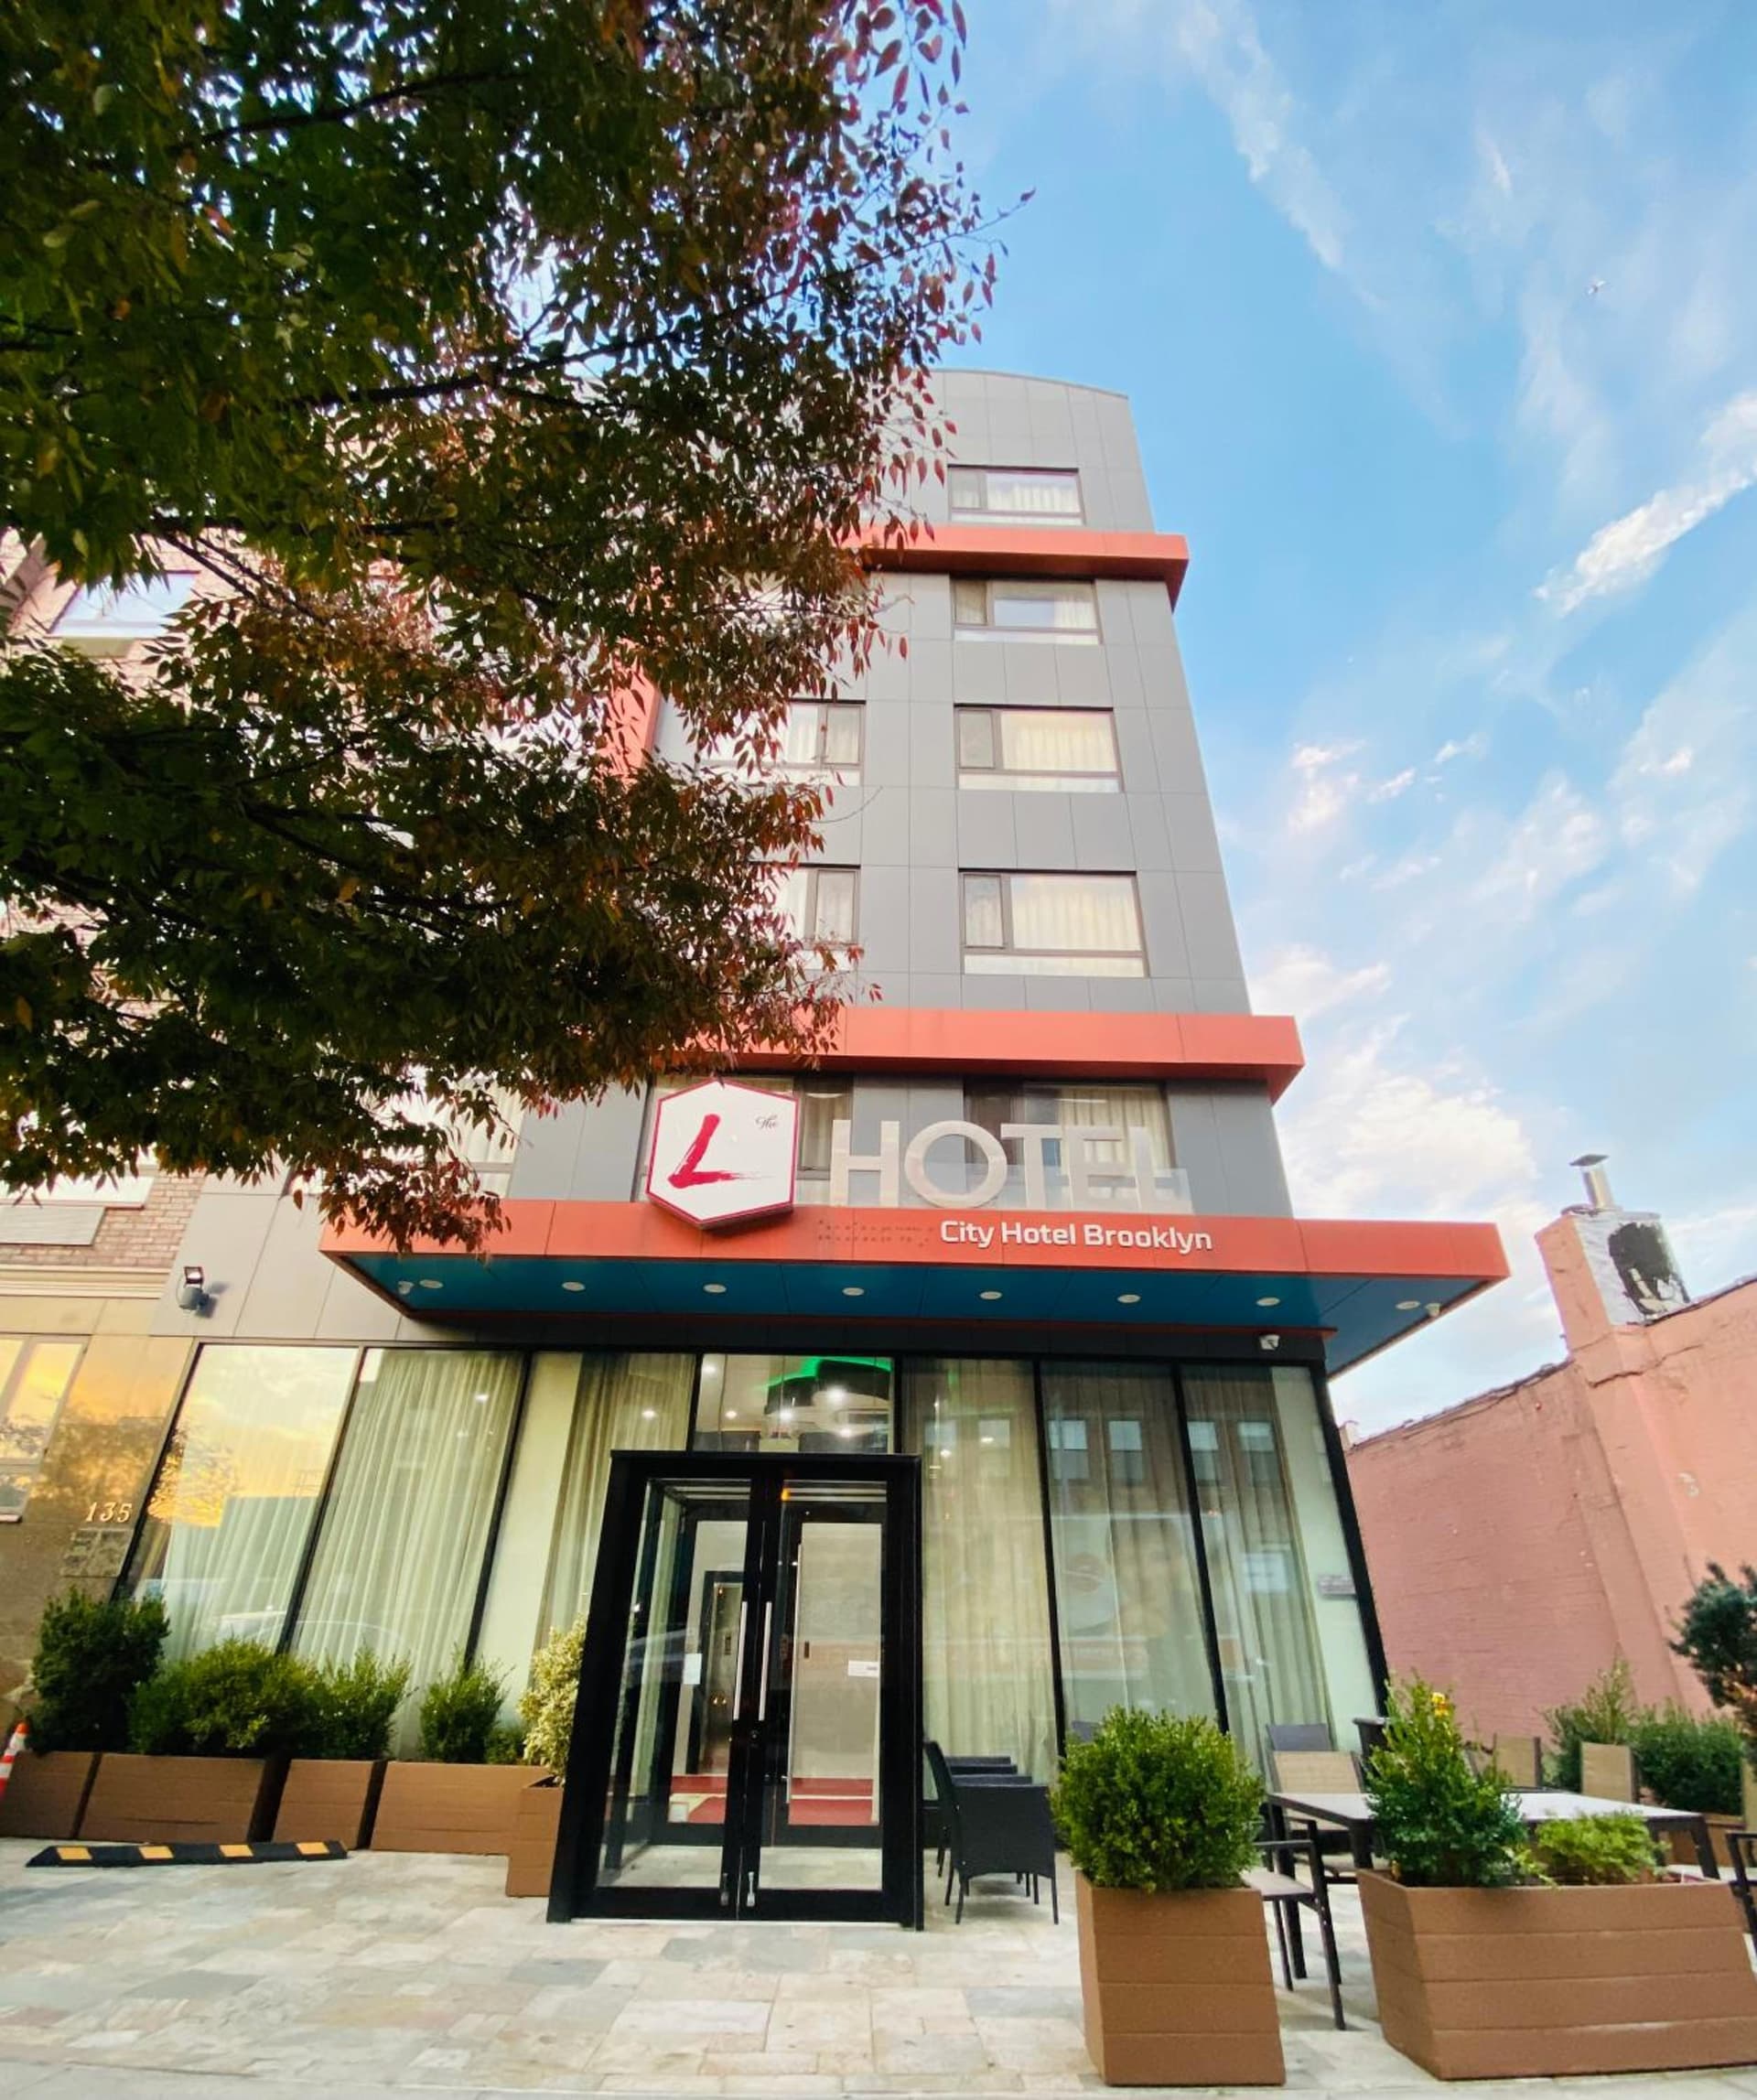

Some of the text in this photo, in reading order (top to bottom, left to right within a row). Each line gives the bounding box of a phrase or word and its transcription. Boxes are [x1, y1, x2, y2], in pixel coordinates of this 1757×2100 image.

[754, 1114, 779, 1130] The
[667, 1113, 769, 1190] L
[829, 1119, 1195, 1216] HOTEL
[940, 1220, 1213, 1255] City Hotel Brooklyn
[85, 1502, 133, 1524] 135
